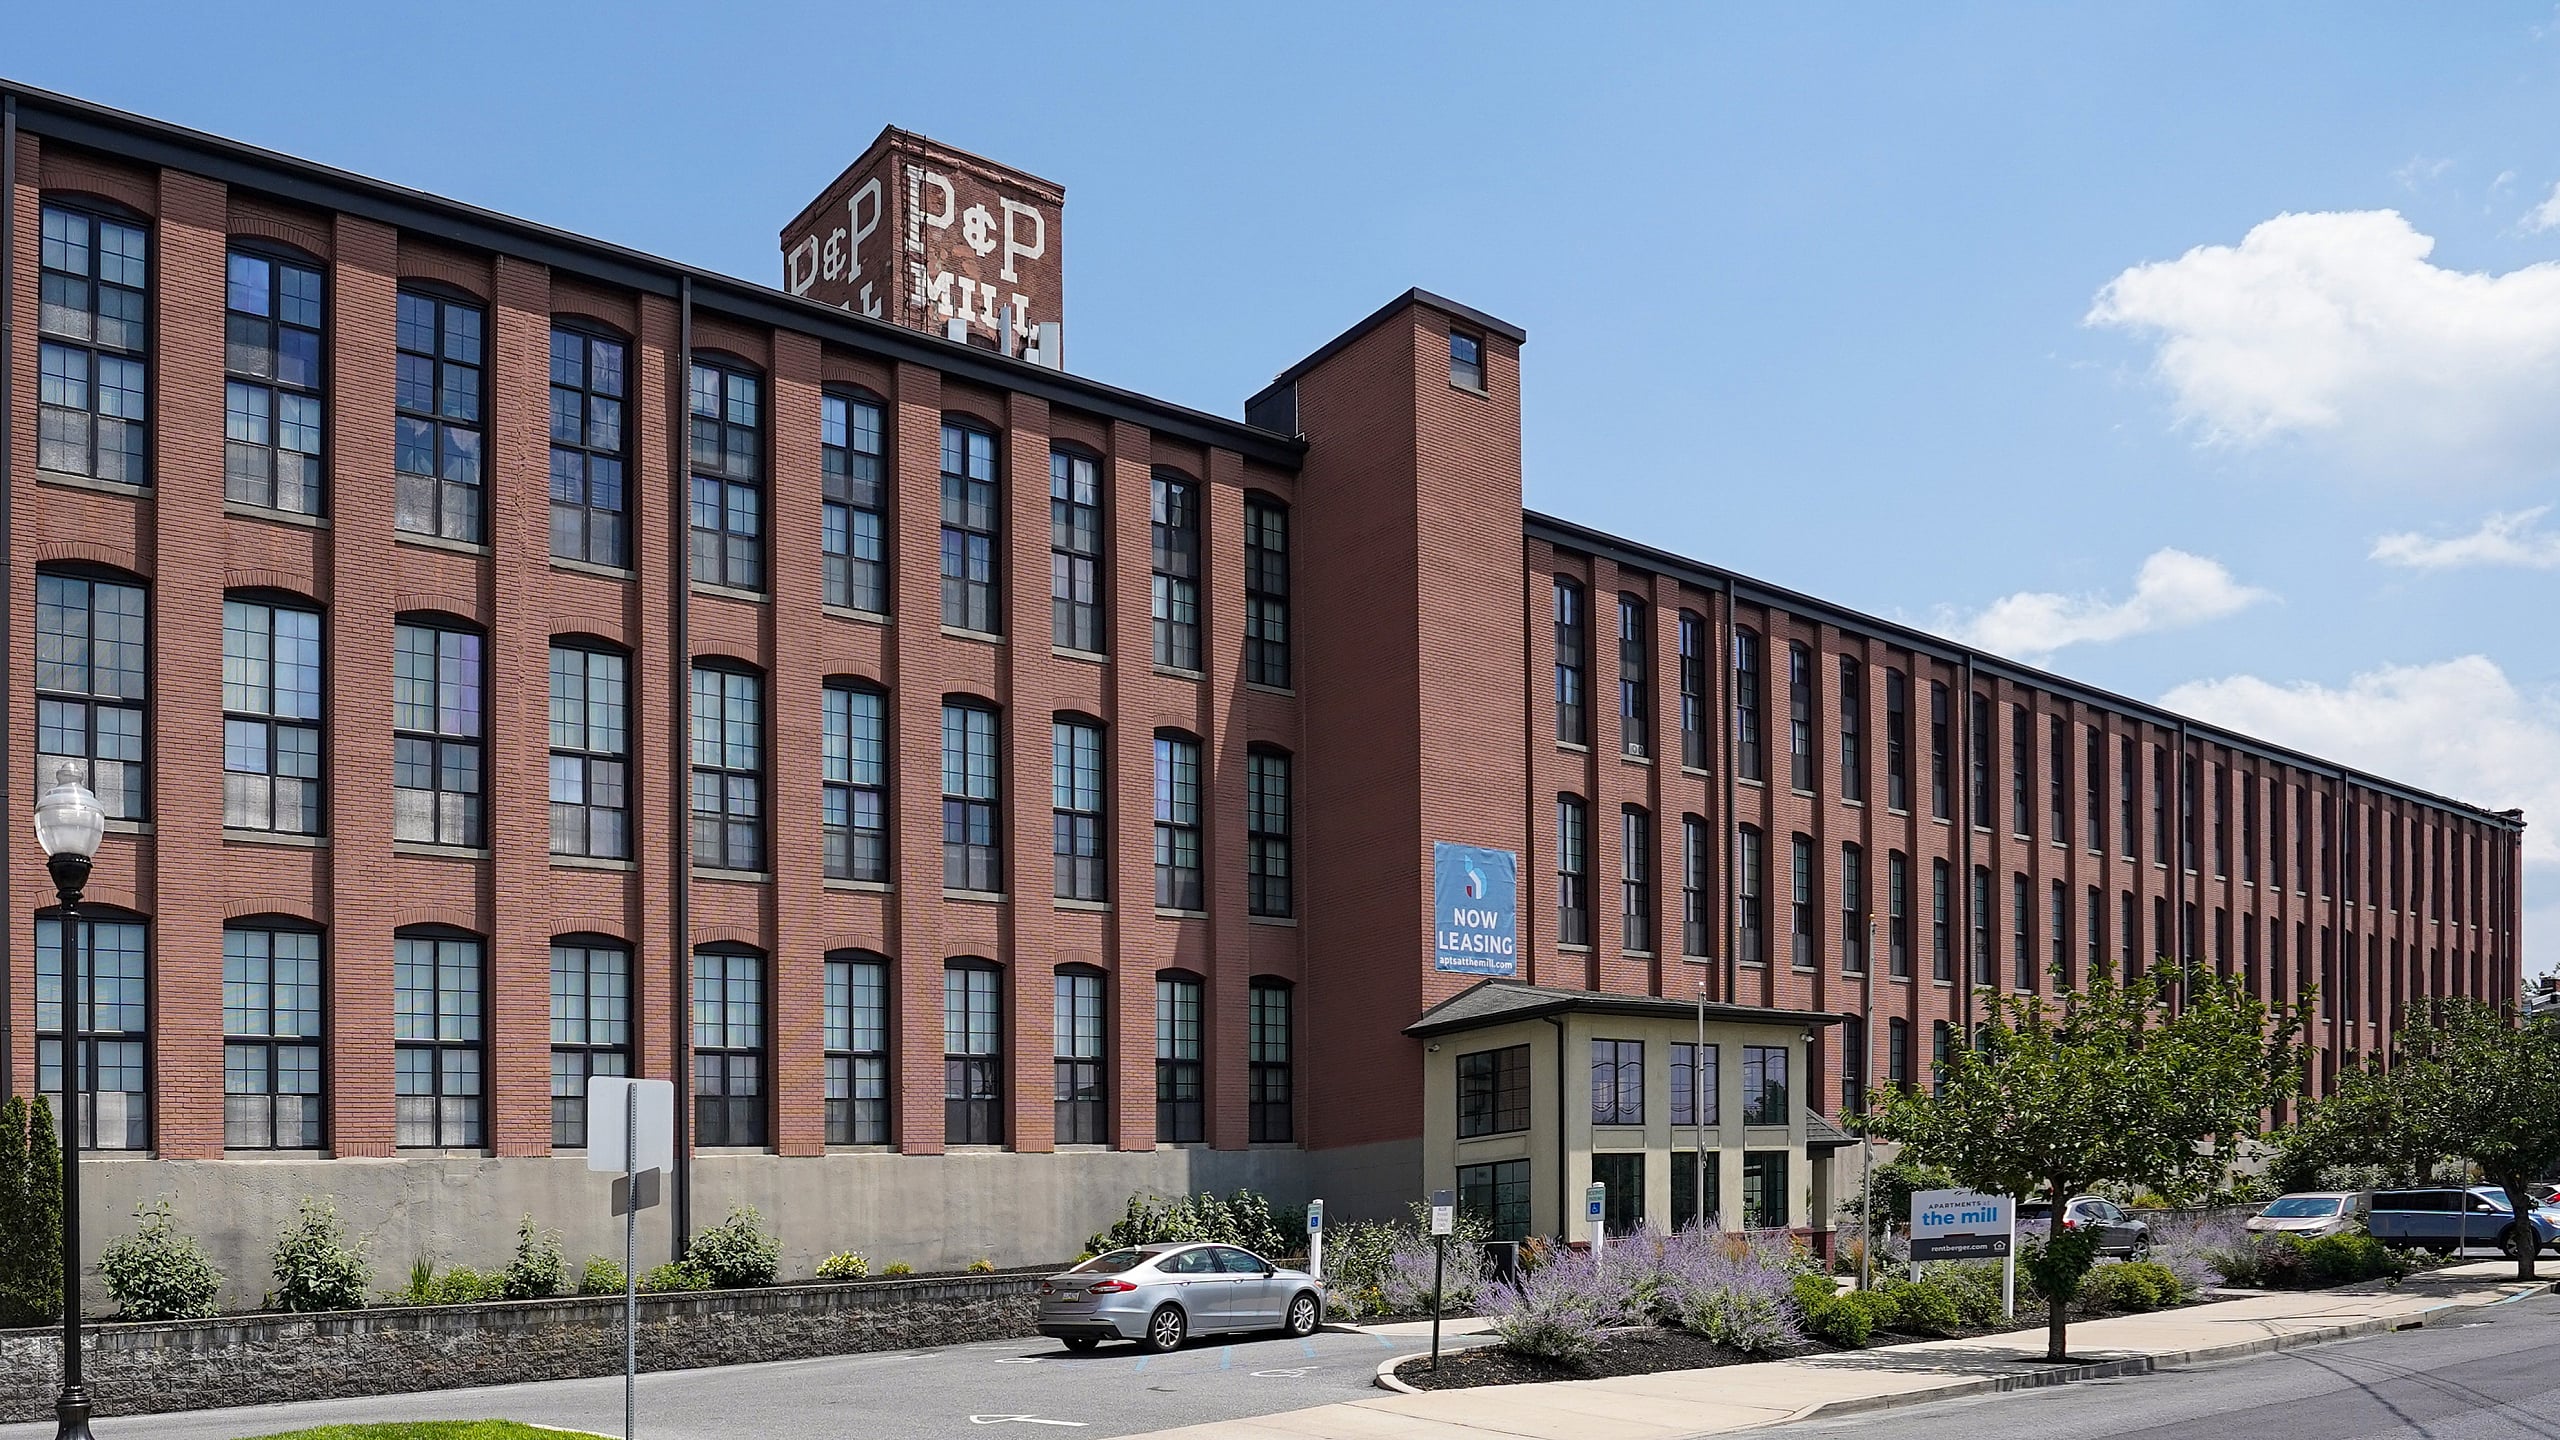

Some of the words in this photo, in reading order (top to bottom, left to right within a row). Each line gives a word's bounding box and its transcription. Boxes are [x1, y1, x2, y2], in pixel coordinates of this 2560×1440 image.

[906, 164, 1045, 283] P&P
[911, 262, 1039, 341] MILL
[1454, 908, 1498, 929] NOW
[1439, 931, 1513, 955] LEASING
[1439, 956, 1513, 969] aptsatthemill.com
[1928, 1201, 1981, 1209] APARTMENTS
[1922, 1211, 1955, 1226] the
[1961, 1207, 1997, 1223] mill
[1931, 1244, 1988, 1252] rentberger.com
